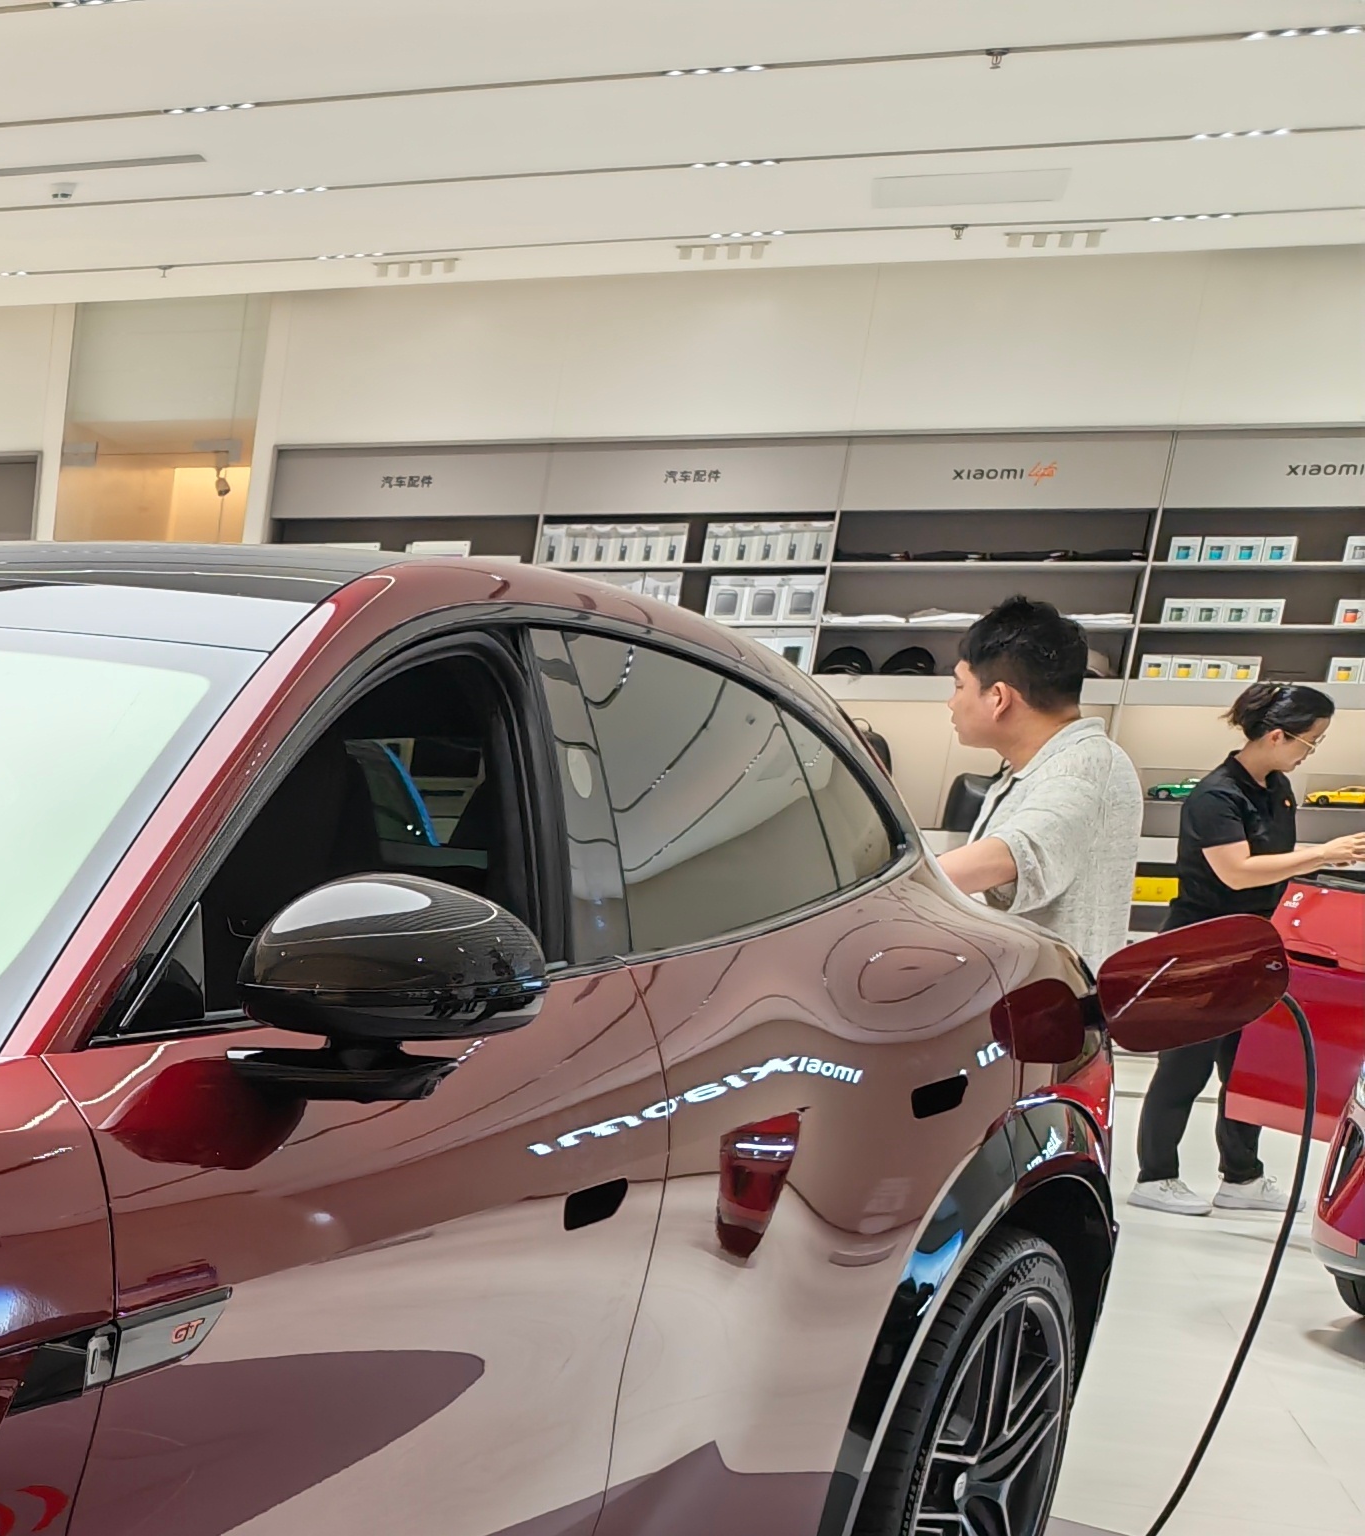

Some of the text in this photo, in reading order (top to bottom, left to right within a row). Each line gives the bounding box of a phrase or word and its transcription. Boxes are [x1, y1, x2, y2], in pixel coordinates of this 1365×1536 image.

[665, 470, 721, 484] 汽车配件
[952, 468, 1024, 480] xiaomi
[381, 475, 433, 489] 汽车配件
[171, 1317, 206, 1344] GT
